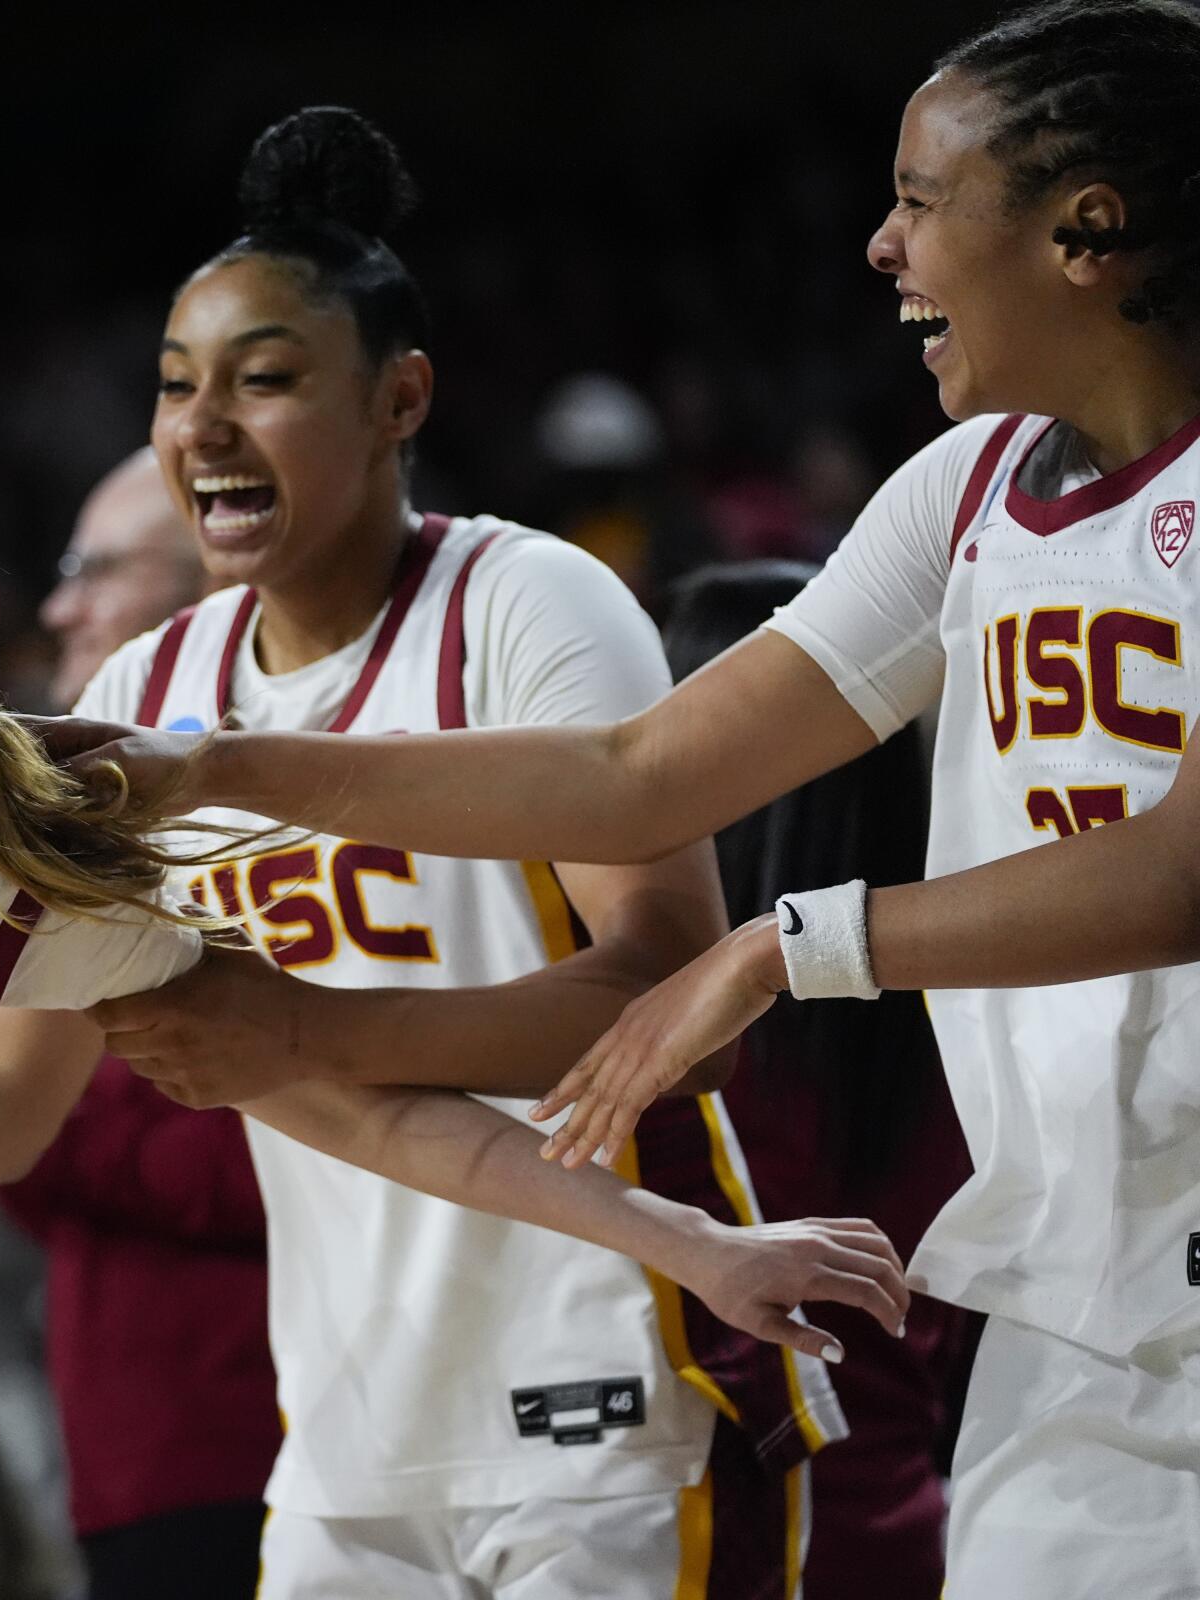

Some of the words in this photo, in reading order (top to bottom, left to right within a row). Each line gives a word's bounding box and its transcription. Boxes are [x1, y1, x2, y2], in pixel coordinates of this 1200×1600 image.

[1155, 504, 1193, 541] PAC
[1160, 528, 1181, 551] 12
[984, 605, 1186, 755] USC
[607, 1390, 633, 1413] 46
